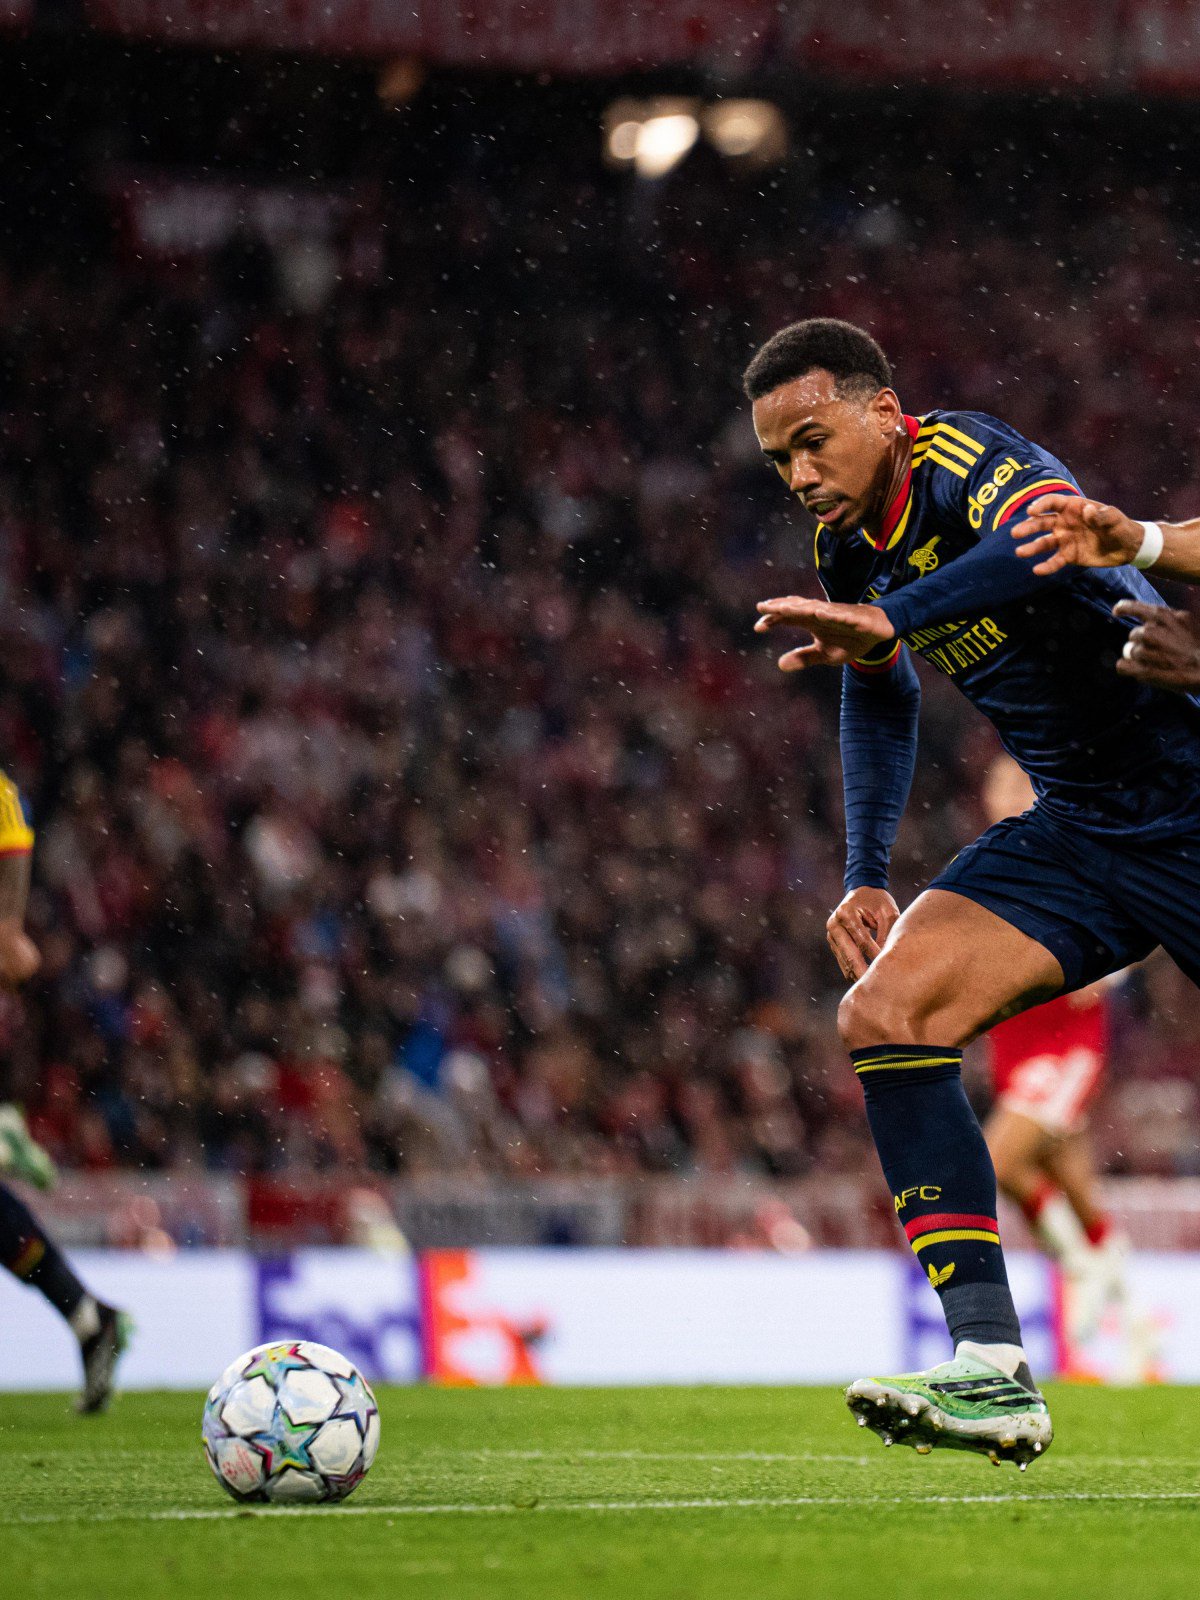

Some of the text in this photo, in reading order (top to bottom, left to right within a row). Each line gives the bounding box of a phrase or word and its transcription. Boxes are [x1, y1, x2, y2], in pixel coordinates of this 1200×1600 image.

[968, 457, 1031, 529] deel.
[945, 616, 1009, 669] BETTER
[894, 1185, 942, 1214] AFC
